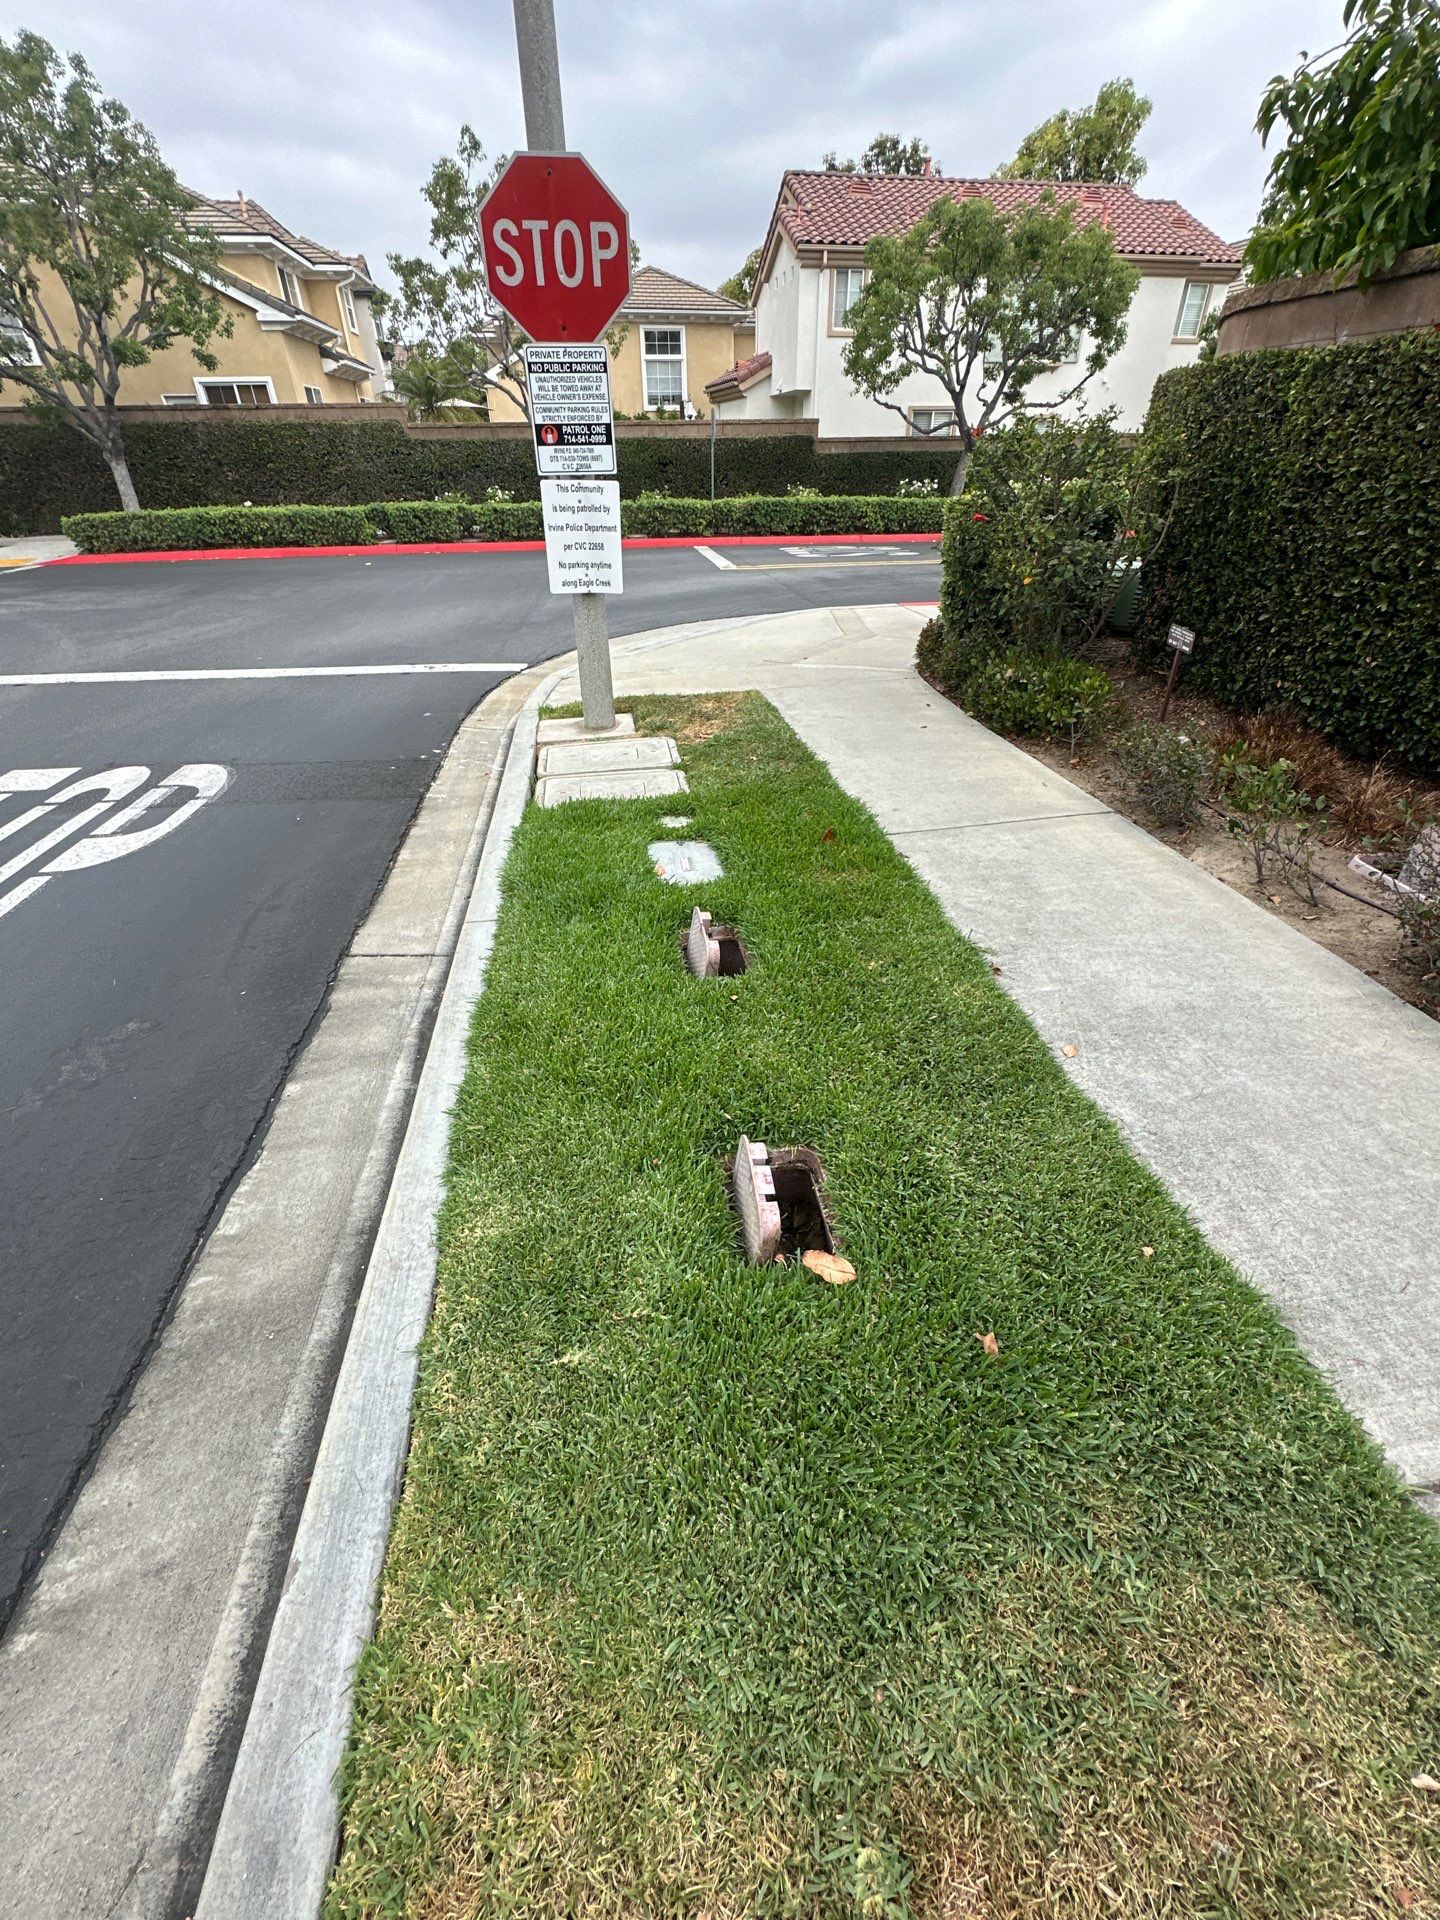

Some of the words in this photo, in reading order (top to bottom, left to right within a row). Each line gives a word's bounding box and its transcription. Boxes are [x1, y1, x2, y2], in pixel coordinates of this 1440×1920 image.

[492, 218, 619, 288] STOP
[530, 351, 560, 359] PRIVATE
[563, 351, 603, 359] PROPERTY
[531, 363, 542, 372] NO
[544, 363, 570, 372] PUBLIC
[572, 363, 604, 372] PARKING
[536, 406, 566, 414] COMMUNITY
[567, 406, 590, 414] PARKING
[591, 406, 608, 414] RULES
[563, 425, 589, 434] PATROL
[591, 425, 606, 434] ONE
[564, 435, 606, 443] 714-541-0999
[556, 485, 569, 493] This
[571, 485, 604, 495] Community
[559, 505, 575, 514] being
[577, 505, 602, 514] patrolled
[603, 505, 610, 515] by
[585, 524, 617, 534] Department
[564, 544, 573, 552] per
[574, 542, 587, 550] CVC
[559, 561, 566, 569] No
[568, 561, 589, 570] parking
[590, 561, 612, 570] anytime
[562, 579, 577, 588] along
[579, 579, 594, 588] Eagle
[595, 579, 611, 587] Creek
